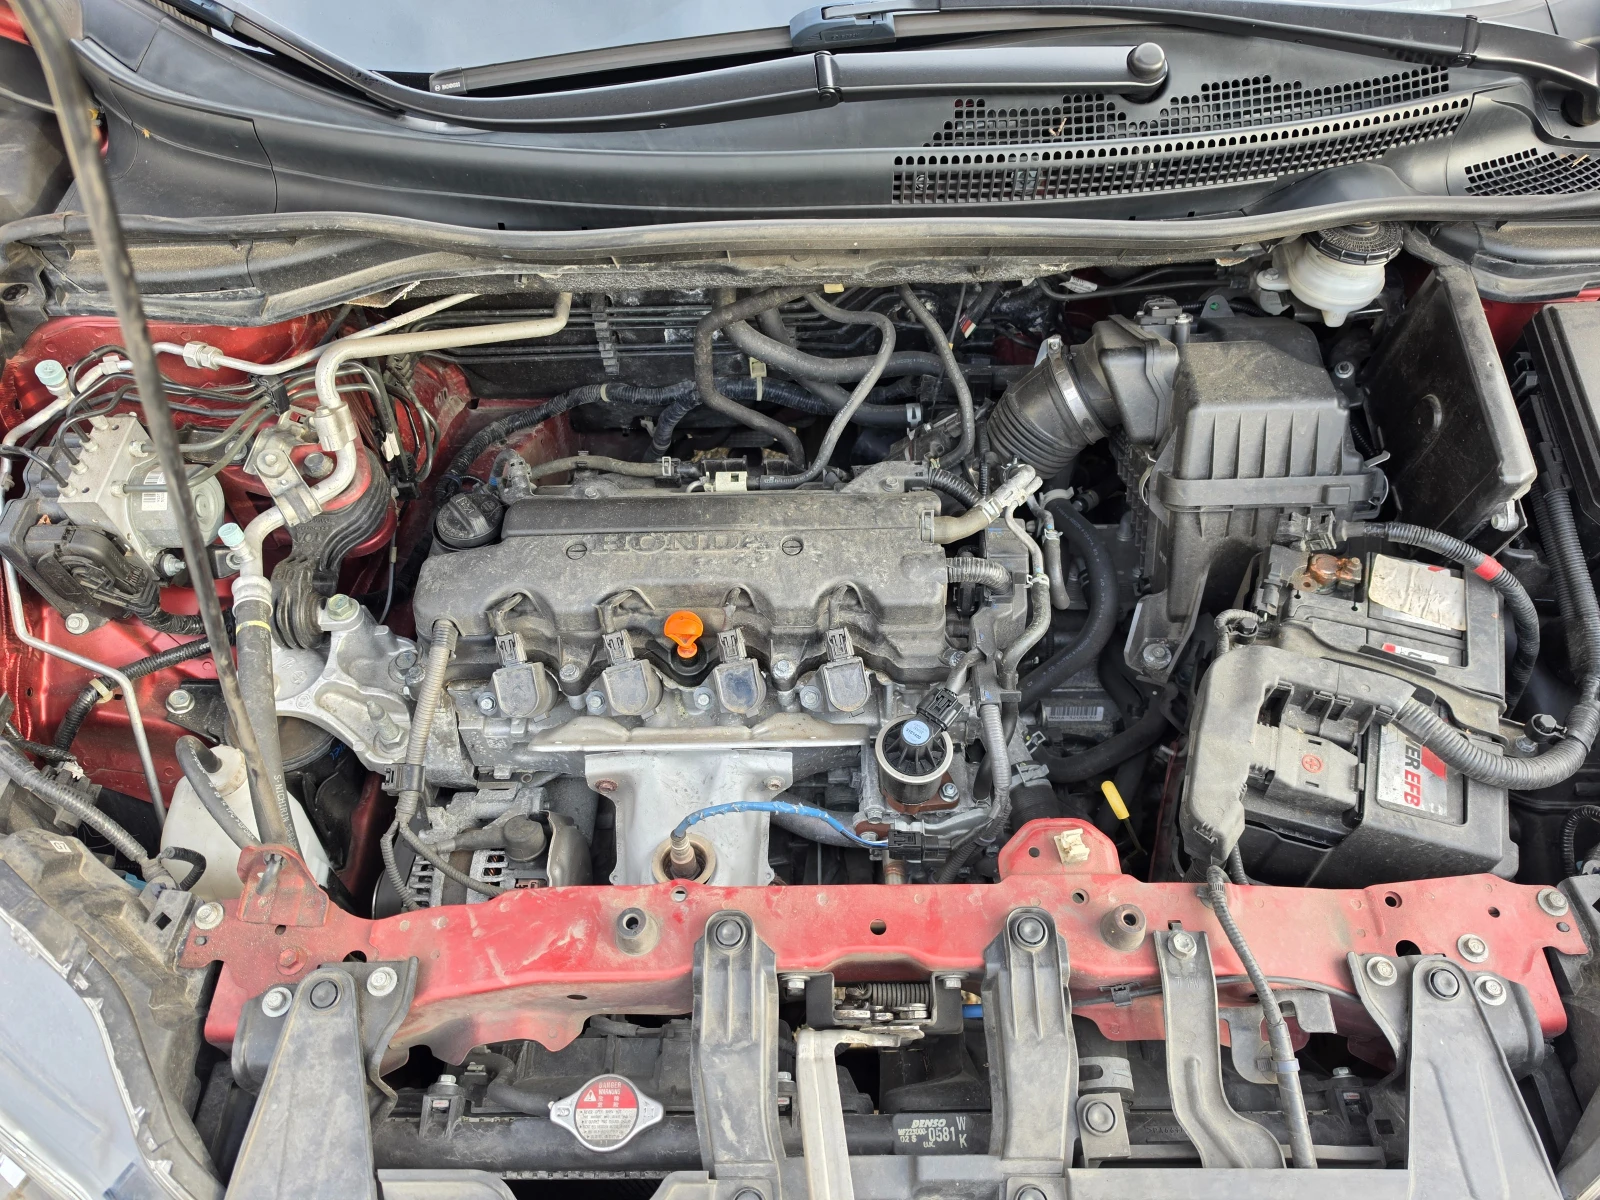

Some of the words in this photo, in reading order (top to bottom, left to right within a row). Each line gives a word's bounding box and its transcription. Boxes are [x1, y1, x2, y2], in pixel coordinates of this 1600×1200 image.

[592, 530, 772, 553] HONDA
[1404, 769, 1421, 807] EFB
[911, 1119, 946, 1128] DENSO
[955, 1116, 966, 1131] W
[928, 1126, 956, 1142] 0581
[958, 1133, 968, 1149] K
